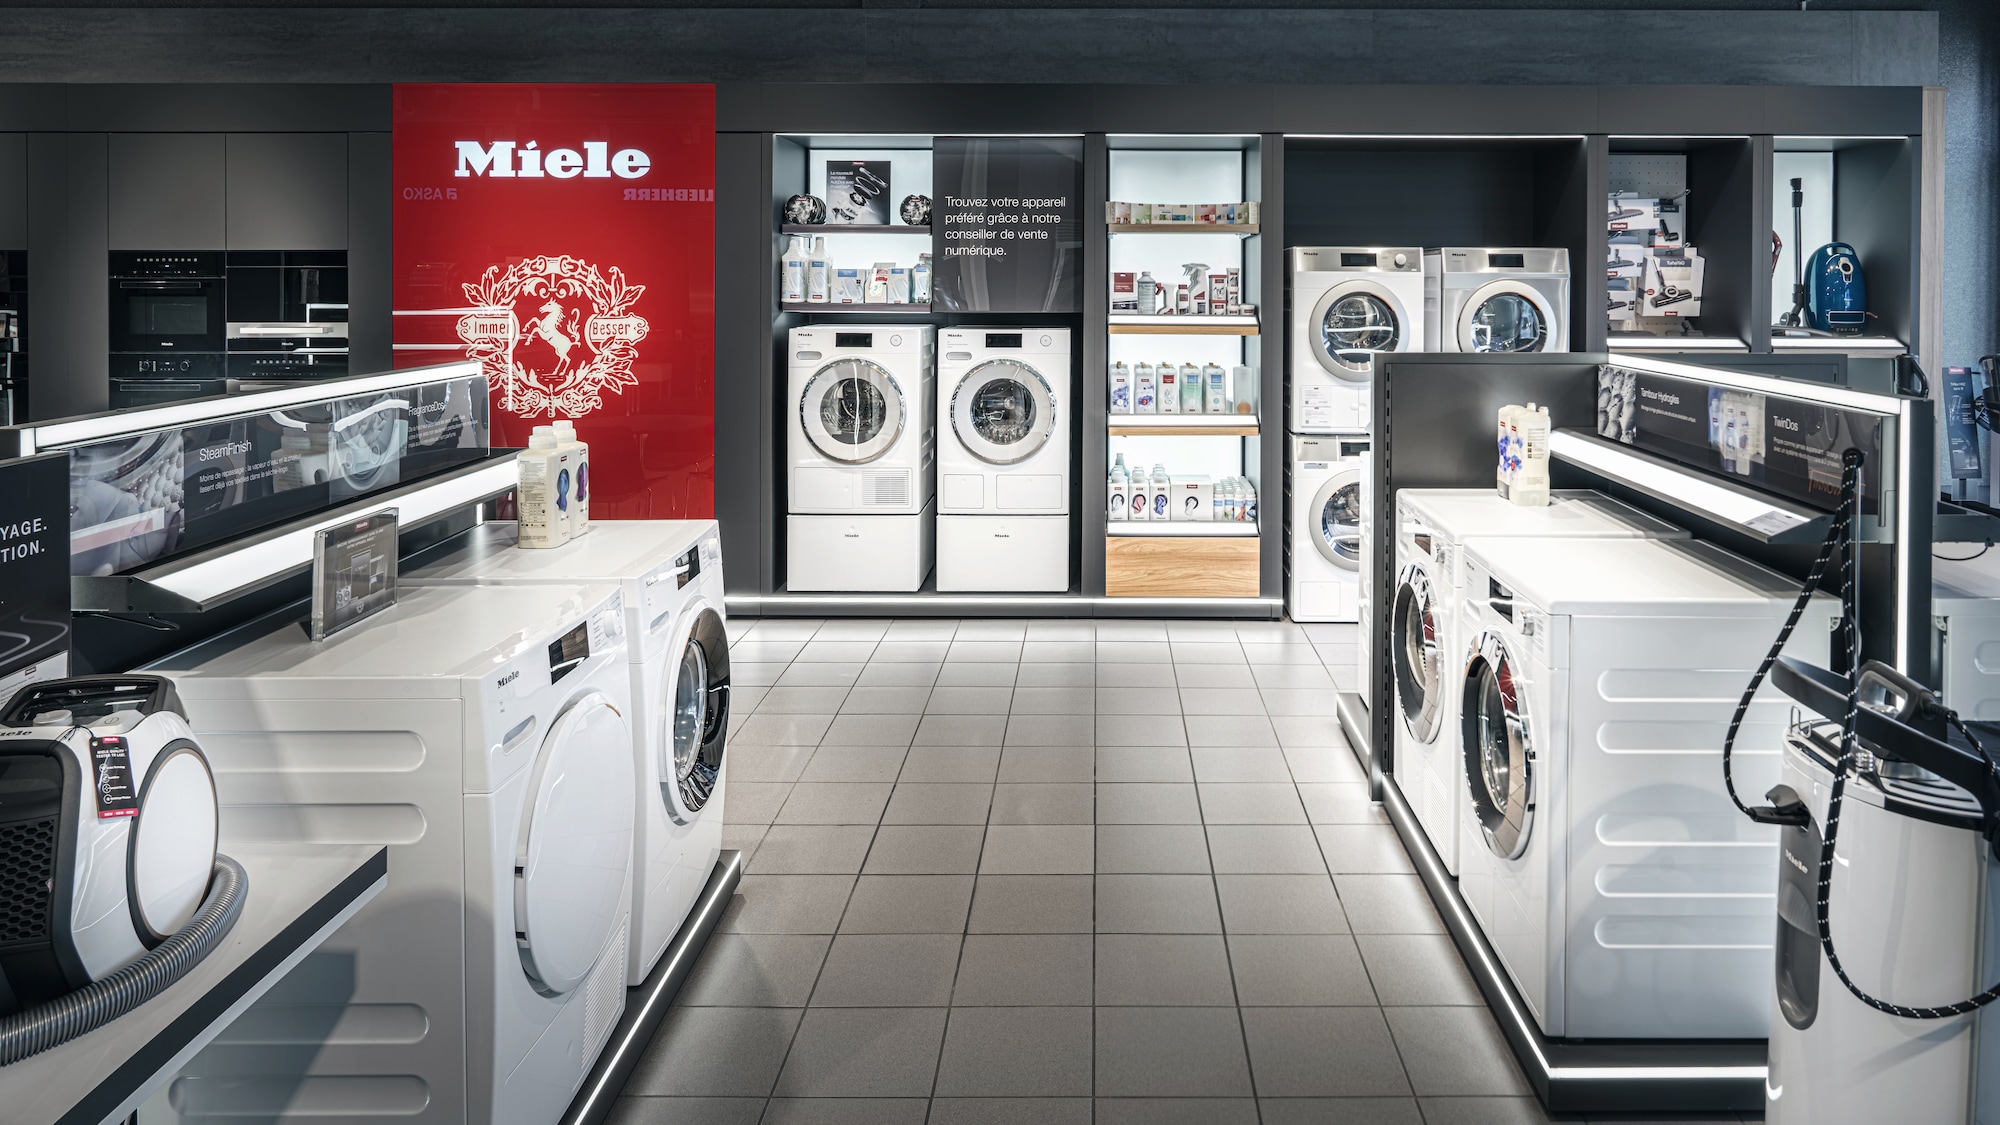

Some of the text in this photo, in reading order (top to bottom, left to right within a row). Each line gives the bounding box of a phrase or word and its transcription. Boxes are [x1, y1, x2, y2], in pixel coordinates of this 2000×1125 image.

[454, 140, 651, 179] Miele
[944, 196, 1066, 209] Trouvez votre appareil
[944, 212, 1061, 226] préféré grâce à notre
[944, 228, 1048, 240] conseiller de vente
[944, 245, 1007, 258] numérique.
[592, 322, 630, 335] Besser
[1773, 415, 1798, 432] TwinDos
[200, 440, 252, 462] SteamFinish
[200, 473, 214, 483] Moins
[0, 540, 45, 564] TION.
[497, 670, 520, 689] Miele
[1785, 848, 1808, 874] Miele
